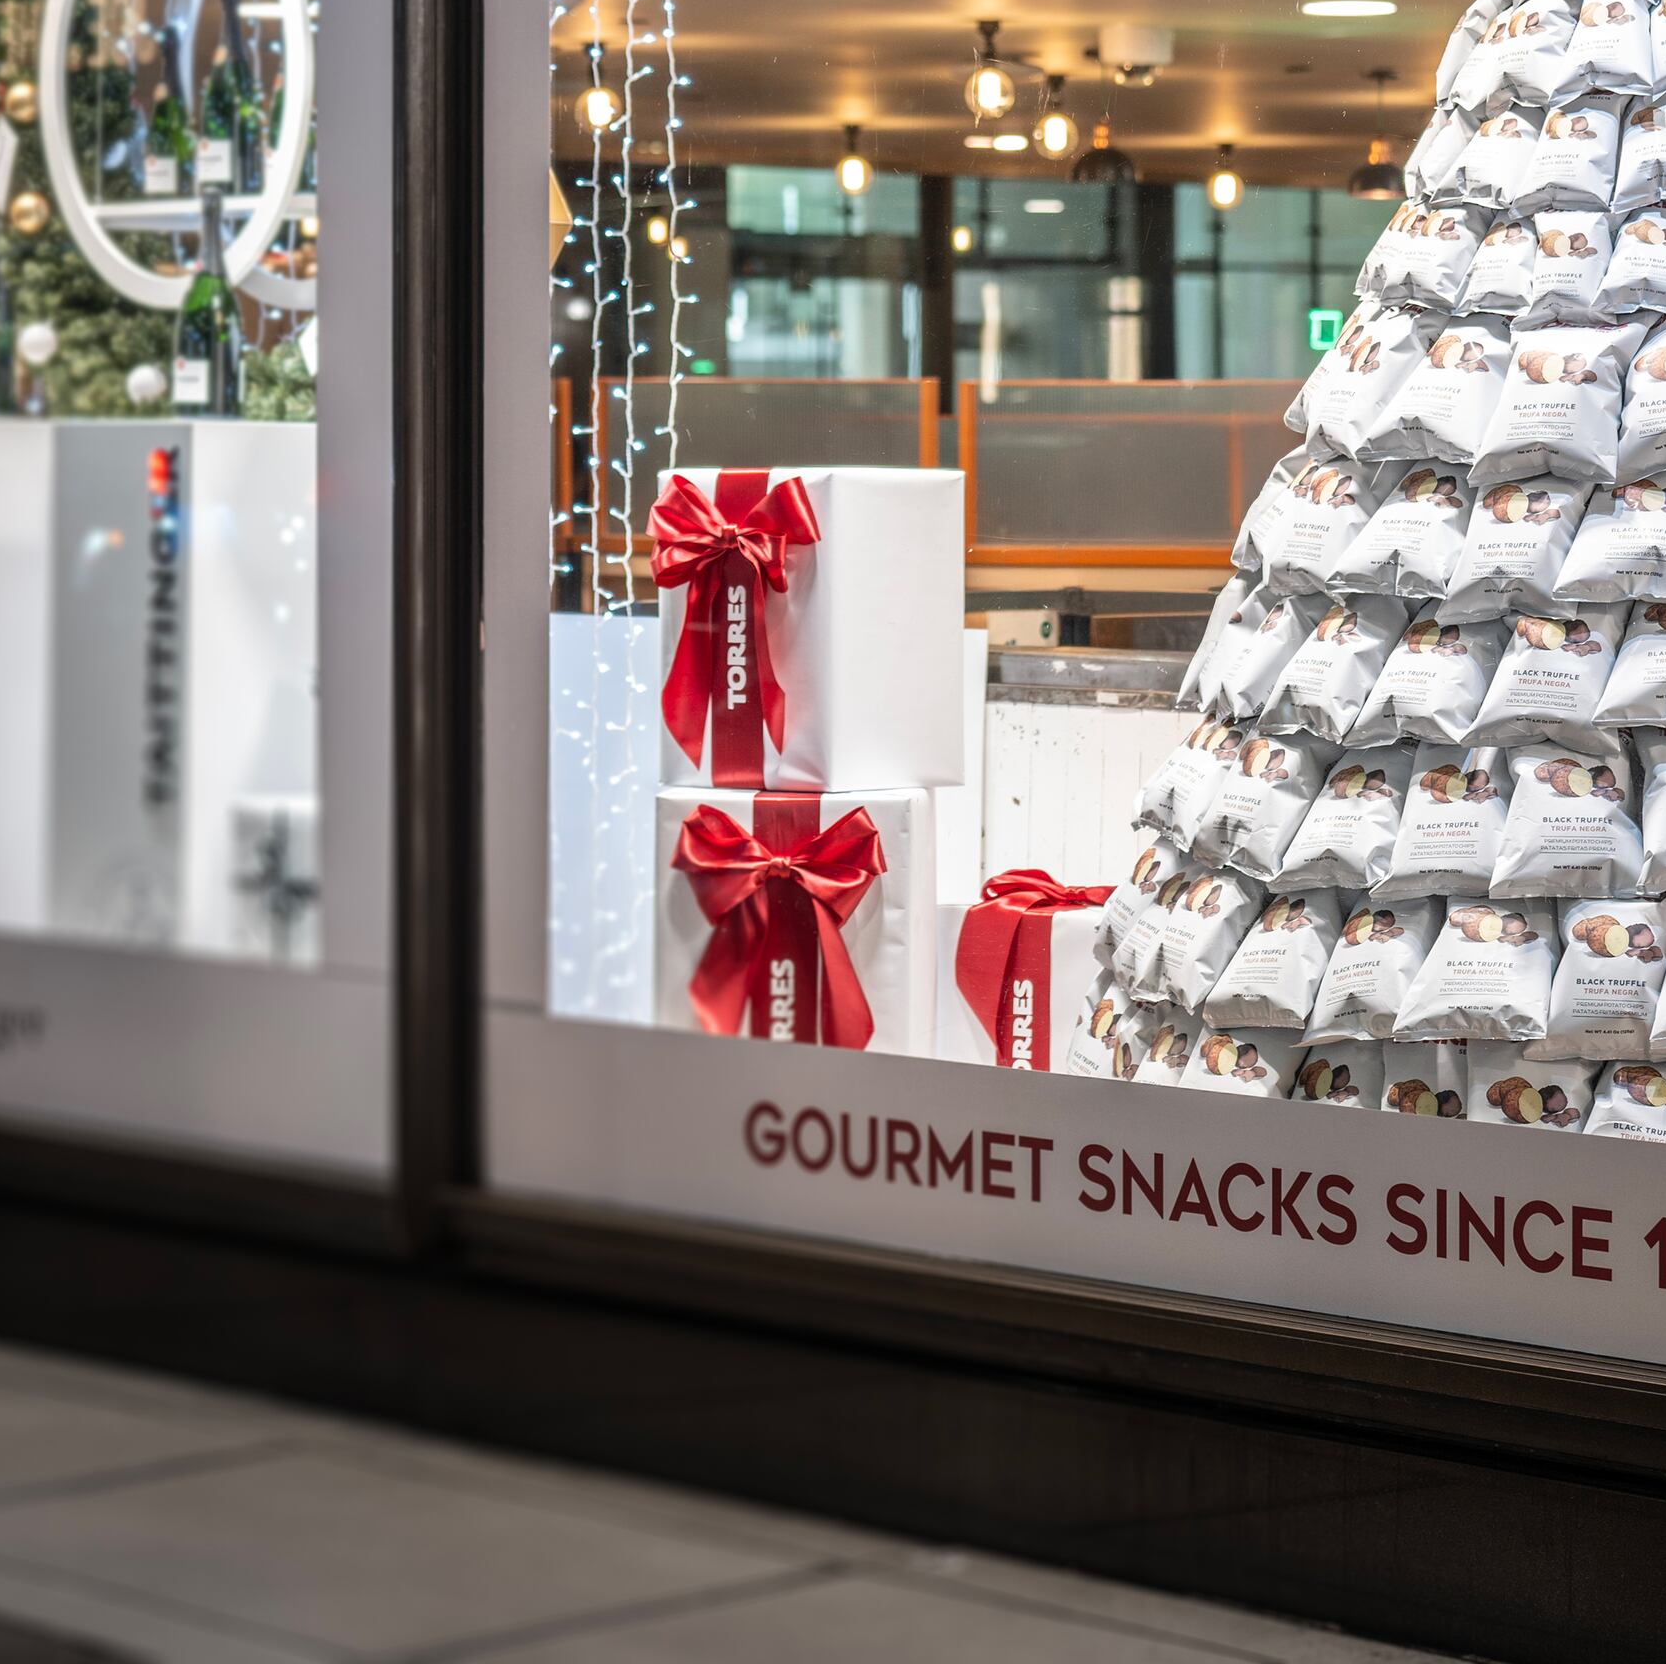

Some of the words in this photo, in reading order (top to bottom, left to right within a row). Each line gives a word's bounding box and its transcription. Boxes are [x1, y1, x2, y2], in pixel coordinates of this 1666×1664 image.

[726, 584, 747, 710] TORRES
[1513, 669, 1540, 677] BLACK
[1543, 671, 1580, 680] TRUFFLE
[1518, 679, 1543, 687] TRUFA
[1543, 816, 1572, 824] BLACK
[1575, 816, 1613, 825] TRUFFLE
[1243, 949, 1259, 957] BLACK
[1333, 965, 1353, 976] BLACK
[1354, 960, 1381, 970] TRUFFLE
[1446, 960, 1473, 968] BLACK
[1476, 960, 1514, 968] TRUFFLE
[1335, 972, 1351, 981] TRUFA
[1352, 969, 1373, 978] NEGRA
[1576, 978, 1605, 986] BLACK
[1609, 979, 1647, 987] TRUFFLE
[1612, 988, 1639, 997] NEGRA
[769, 958, 796, 1041] RRES
[1011, 979, 1034, 1070] RRES
[1613, 1122, 1642, 1133] BLACK
[744, 1100, 1054, 1202] GOURMET
[1077, 1142, 1358, 1246] SNACKS
[1385, 1182, 1614, 1282] SINCE
